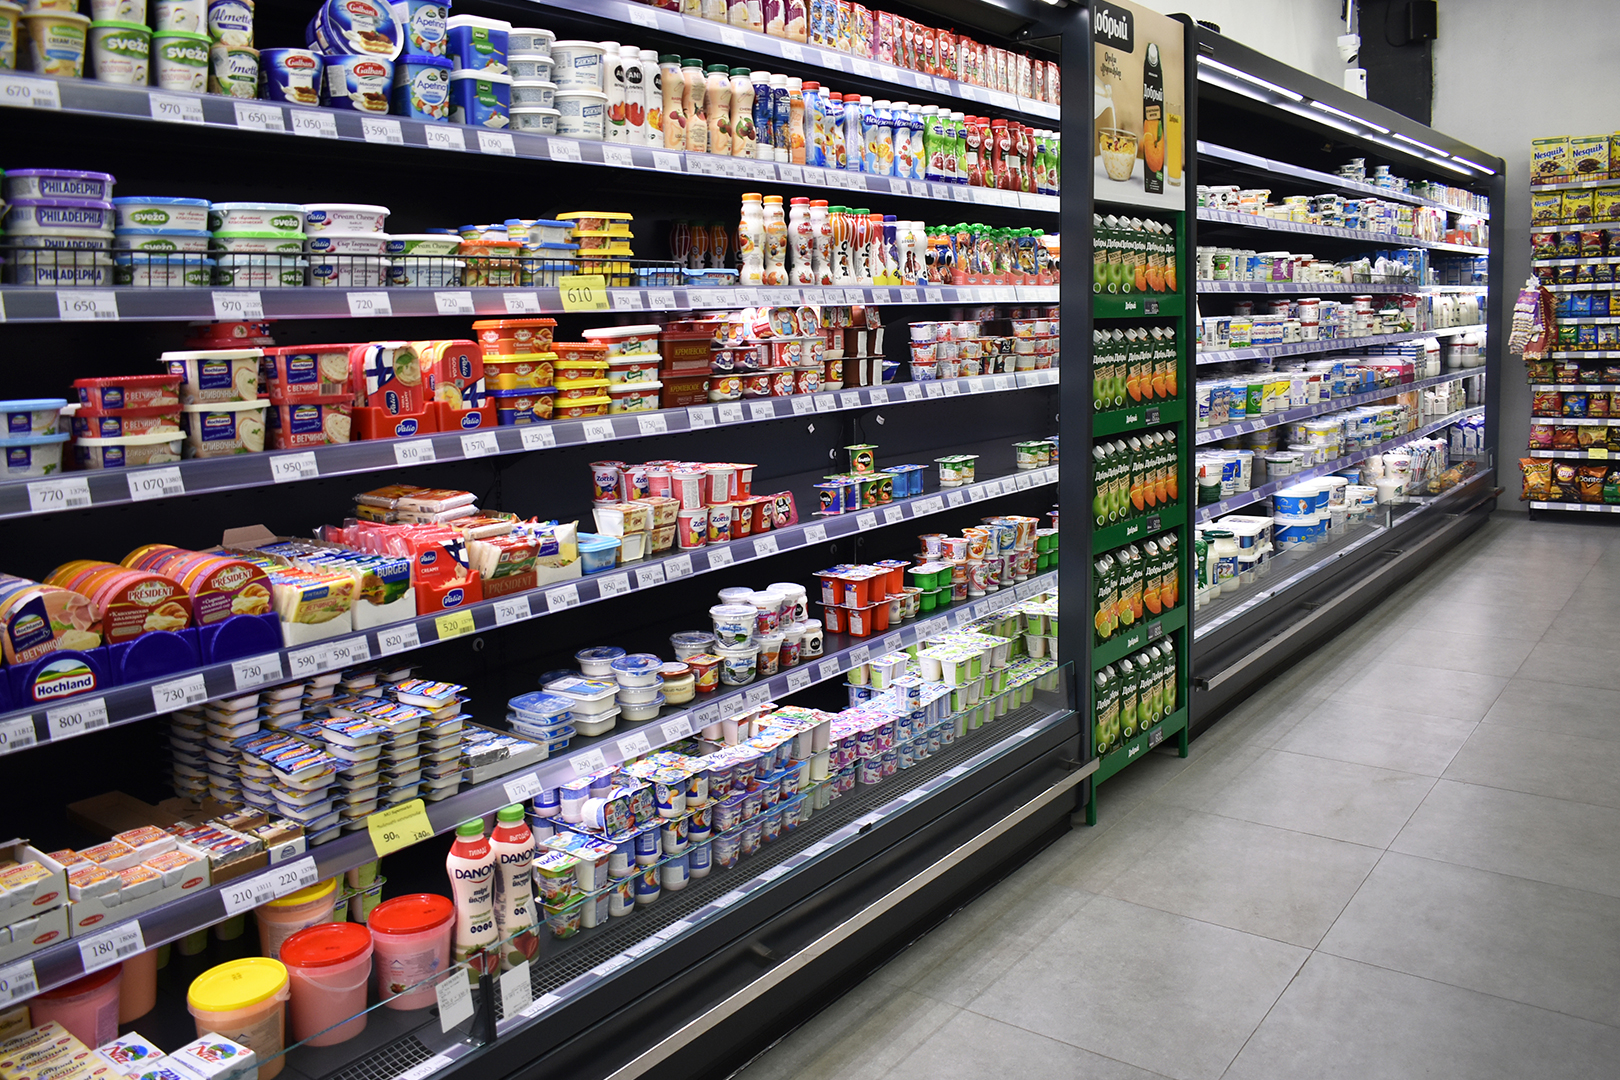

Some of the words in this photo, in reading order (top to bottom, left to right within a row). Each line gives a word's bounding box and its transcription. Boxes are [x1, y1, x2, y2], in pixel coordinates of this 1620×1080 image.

[347, 3, 375, 17] Galbani
[212, 9, 252, 25] Almette
[287, 59, 313, 68] Galbani
[357, 65, 384, 76] Galbani
[6, 85, 30, 98] 670
[159, 103, 180, 115] 970
[248, 113, 267, 123] 650
[304, 119, 321, 129] 050
[371, 126, 388, 136] 590
[1534, 146, 1564, 160] Nesquik
[1573, 144, 1604, 157] Nesquik
[691, 160, 701, 169] 390
[42, 181, 103, 195] PHILADELPHIA
[1534, 198, 1558, 207] Nesquik
[39, 209, 102, 223] PHILADELPHIA
[135, 211, 165, 222] sveža
[274, 217, 298, 227] sveža
[356, 213, 375, 221] Cheese
[568, 287, 593, 303] 610
[74, 300, 97, 312] 650
[222, 301, 242, 312] 970
[356, 300, 373, 309] 720
[442, 298, 457, 307] 720
[510, 300, 524, 309] 730
[461, 356, 470, 376] Valio
[292, 382, 319, 392] ВЕТЧИНОЙ
[131, 389, 163, 400] ВЕТЧИНОЙ
[199, 389, 239, 400] СЛИВОЧНЫЙ
[390, 393, 398, 414] Valio
[130, 418, 162, 429] ВЕТЧИНОЙ
[462, 417, 479, 426] Valio
[397, 424, 417, 433] Valio
[297, 432, 328, 443] ВЕТЧИНОЙ
[202, 440, 243, 452] СЛИВОЧНЫЙ
[471, 440, 486, 450] 570
[402, 448, 418, 458] 810
[283, 462, 301, 473] 950
[143, 478, 164, 489] 070
[40, 489, 64, 503] 770
[420, 553, 435, 563] Valio
[378, 563, 408, 578] BURGER
[421, 566, 439, 574] CREAMY
[669, 562, 681, 572] 370
[211, 568, 254, 589] PRÉSIDENT
[641, 572, 653, 583] 590
[488, 575, 532, 593] PRÉSIDENT
[603, 580, 616, 592] 950
[128, 586, 174, 601] PRÉSIDENT
[444, 594, 462, 604] Valio
[553, 595, 566, 605] 800
[501, 606, 515, 617] 730
[15, 620, 43, 635] Hochland
[443, 620, 459, 633] 520
[386, 635, 402, 647] 820
[23, 638, 64, 661] ВЕТЧИНОЙ
[334, 647, 351, 661] 590
[297, 655, 315, 668] 590
[242, 666, 262, 679] 730
[37, 676, 92, 696] Hochland
[163, 688, 185, 703] 730
[723, 702, 734, 713] 350
[59, 713, 83, 729] 800
[698, 711, 710, 722] 900
[624, 742, 637, 753] 530
[577, 759, 591, 771] 290
[512, 784, 527, 796] 170
[501, 847, 536, 865] DANON
[455, 860, 497, 880] DANON
[278, 871, 298, 887] 220
[233, 888, 253, 905] 210
[91, 940, 114, 958] 180
